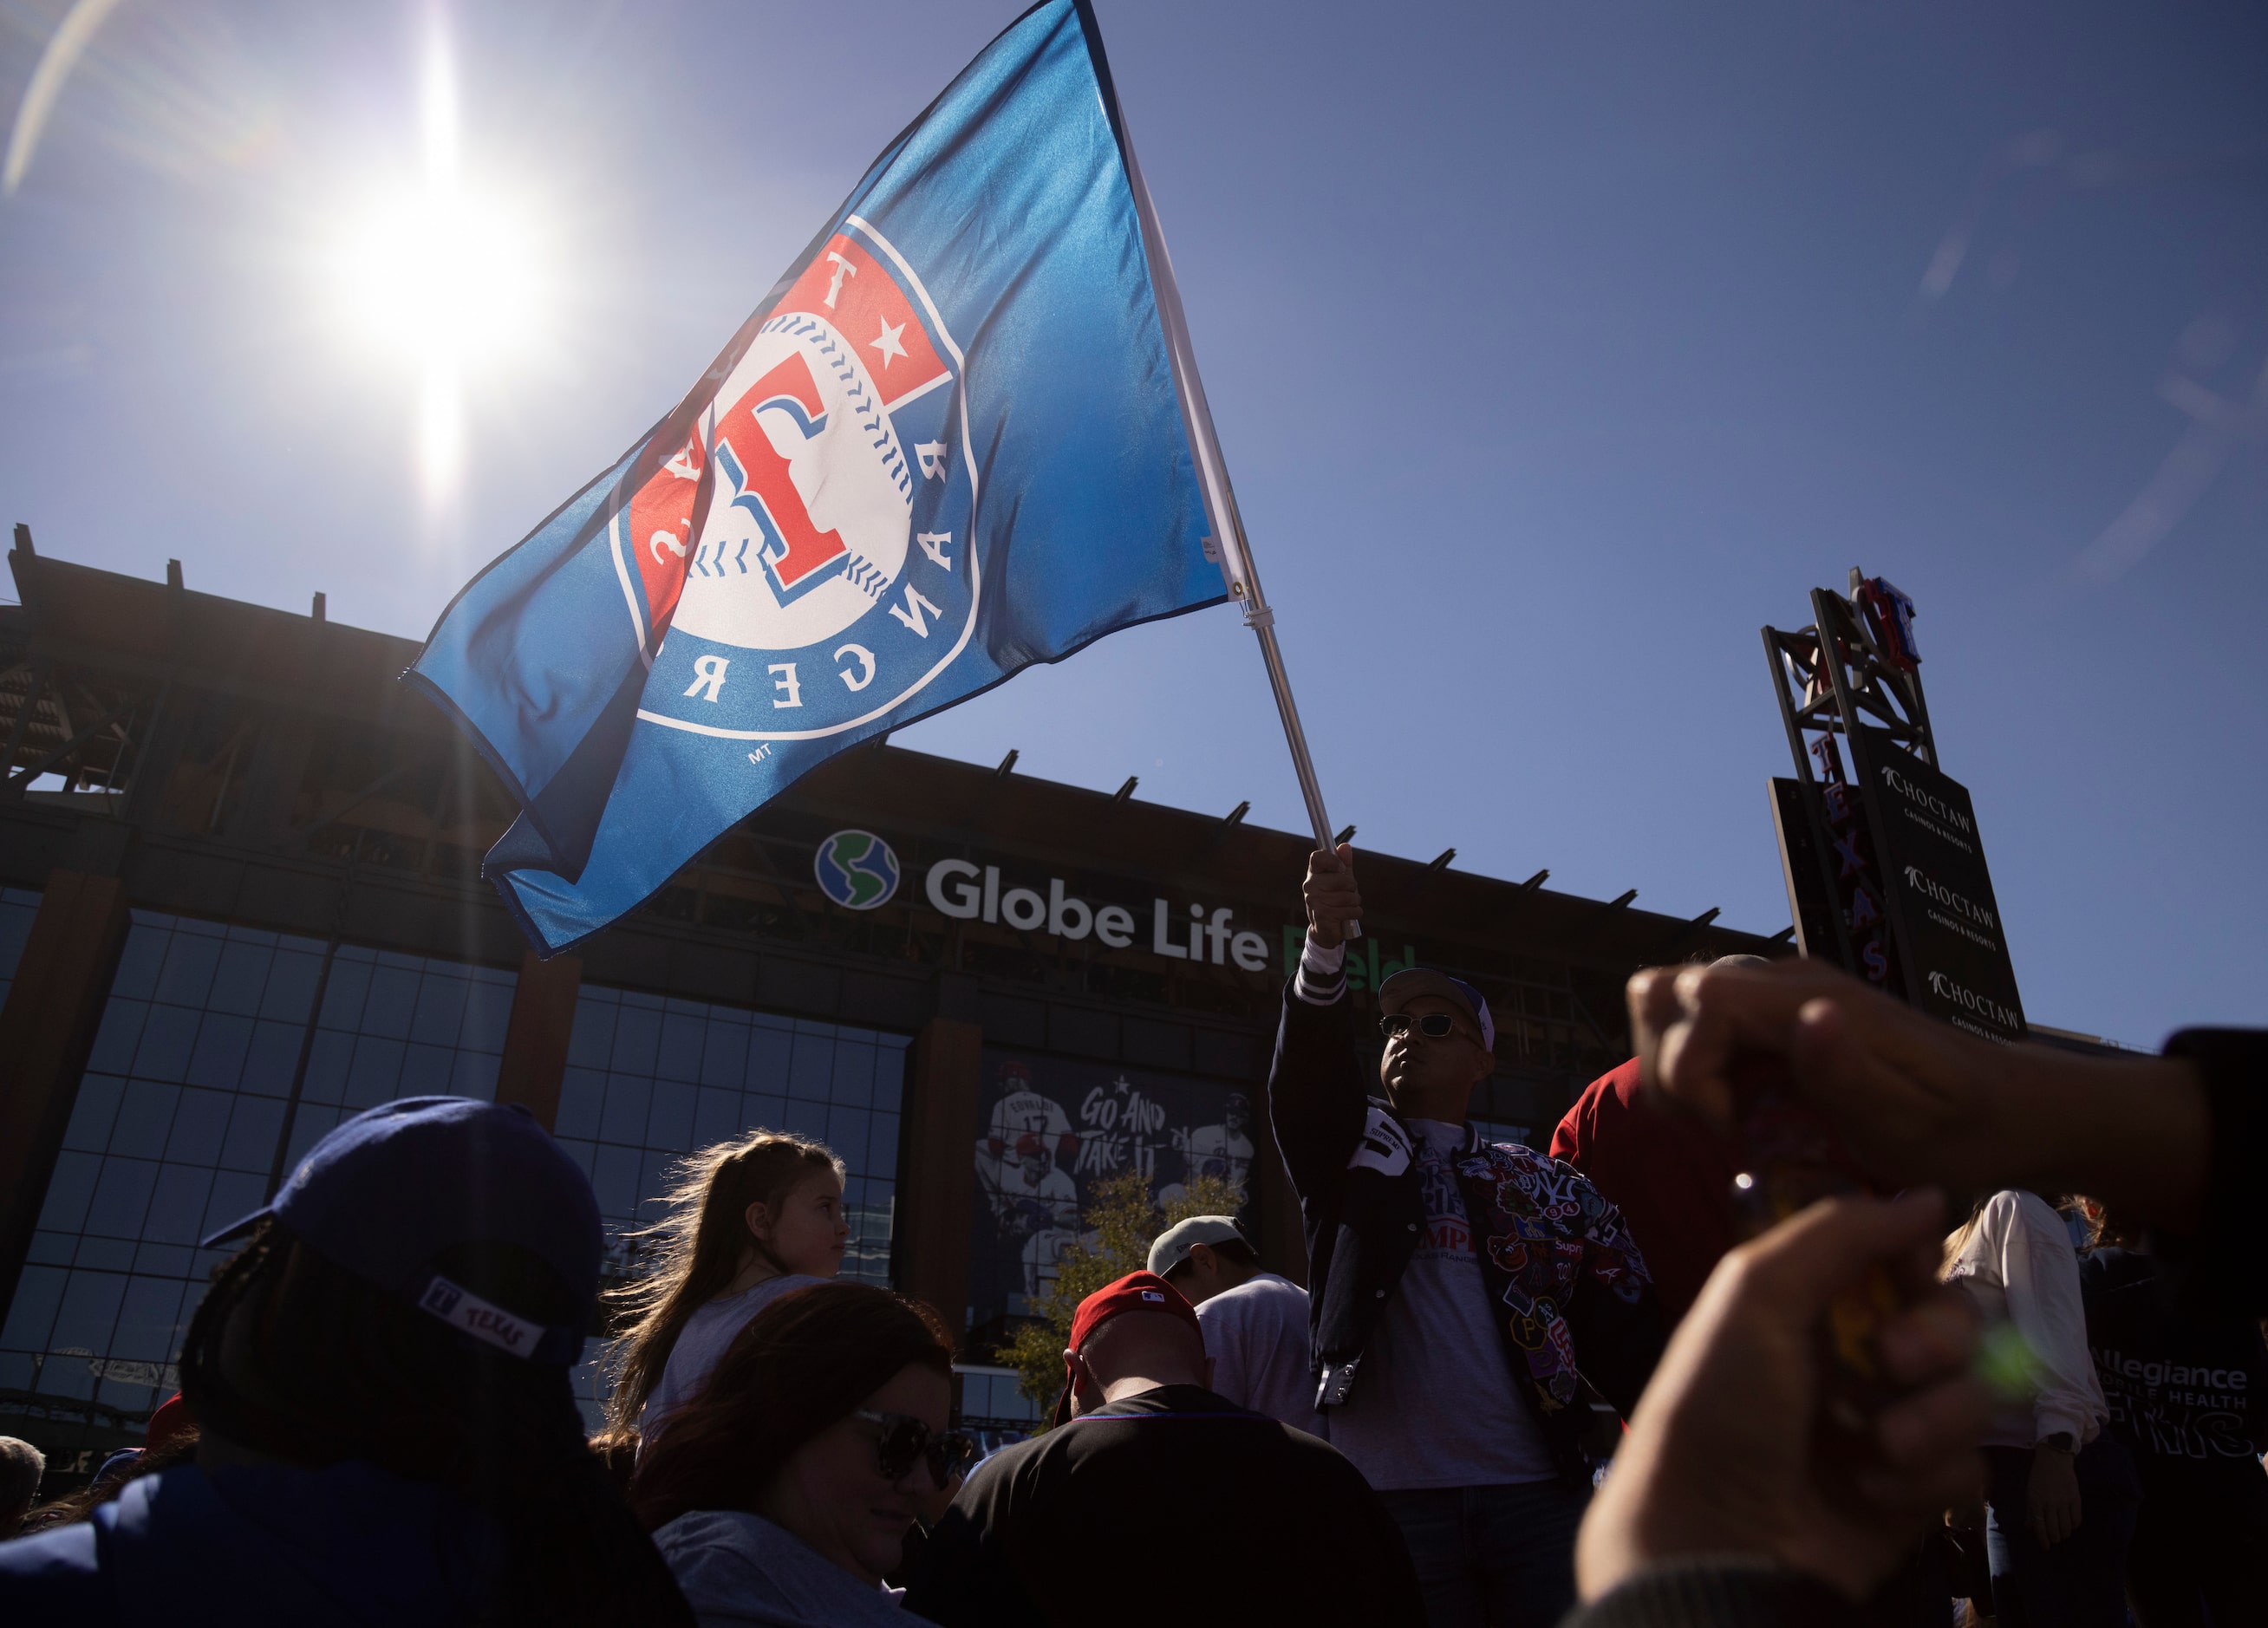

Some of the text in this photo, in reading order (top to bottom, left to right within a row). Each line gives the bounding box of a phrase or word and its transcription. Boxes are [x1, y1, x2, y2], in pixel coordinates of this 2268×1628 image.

[1891, 770, 1970, 833] CHOCTAW
[1811, 731, 1887, 981] TEXAS
[1904, 808, 1935, 832] CASINOS
[1943, 830, 1972, 853] RESORTS
[925, 858, 1415, 992] Globe Life Feld
[1913, 870, 1994, 930] CHOCTAW
[1927, 908, 1959, 933] CASINOS
[1967, 928, 1997, 952] RESORTS
[1937, 973, 2019, 1031] CHOCTAW
[1952, 1015, 1984, 1037] CASINOS
[1080, 1086, 1166, 1136] GO AND
[1072, 1130, 1168, 1184] TAKE IT
[466, 1308, 524, 1345] TEXAS
[2167, 1389, 2248, 1410] HEALTH
